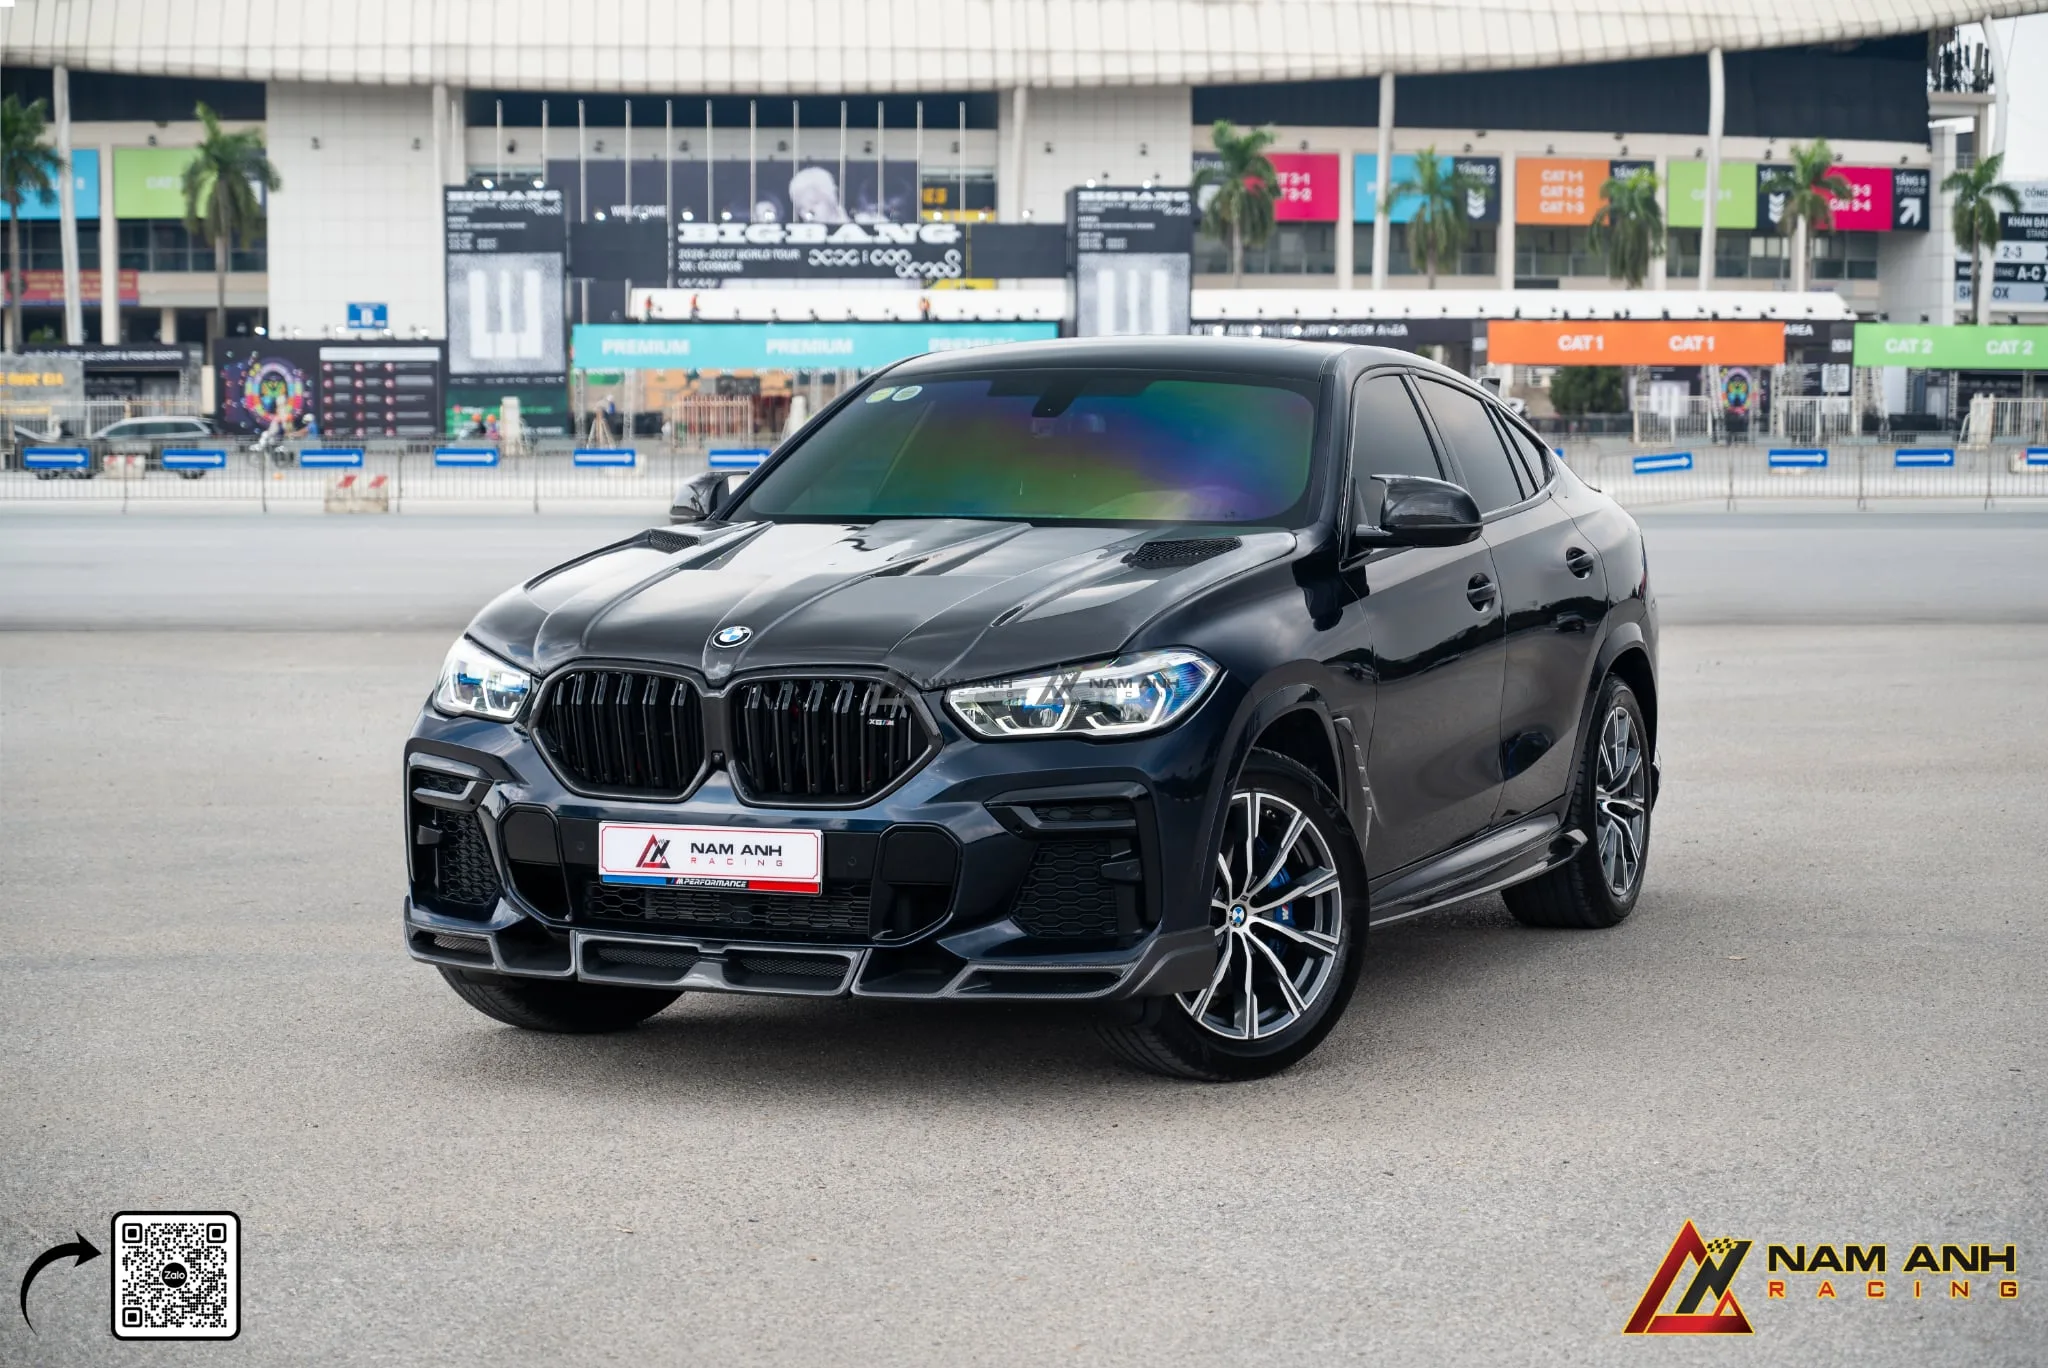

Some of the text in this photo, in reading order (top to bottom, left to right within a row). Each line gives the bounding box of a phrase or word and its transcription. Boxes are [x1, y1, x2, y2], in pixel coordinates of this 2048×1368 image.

[1541, 170, 1565, 182] CAT
[1541, 186, 1565, 198] CAT
[1540, 202, 1564, 214] CAT
[677, 223, 962, 244] BIGBANG
[602, 339, 690, 356] PREMIUM
[766, 338, 853, 356] PREMIUM
[1558, 335, 1604, 351] CAT 1
[1669, 335, 1714, 351] CAT 1
[1885, 338, 1933, 353] CAT 2
[1986, 340, 2034, 355] CAT 2
[690, 842, 782, 857] NAM ANH
[690, 856, 783, 867] RACING
